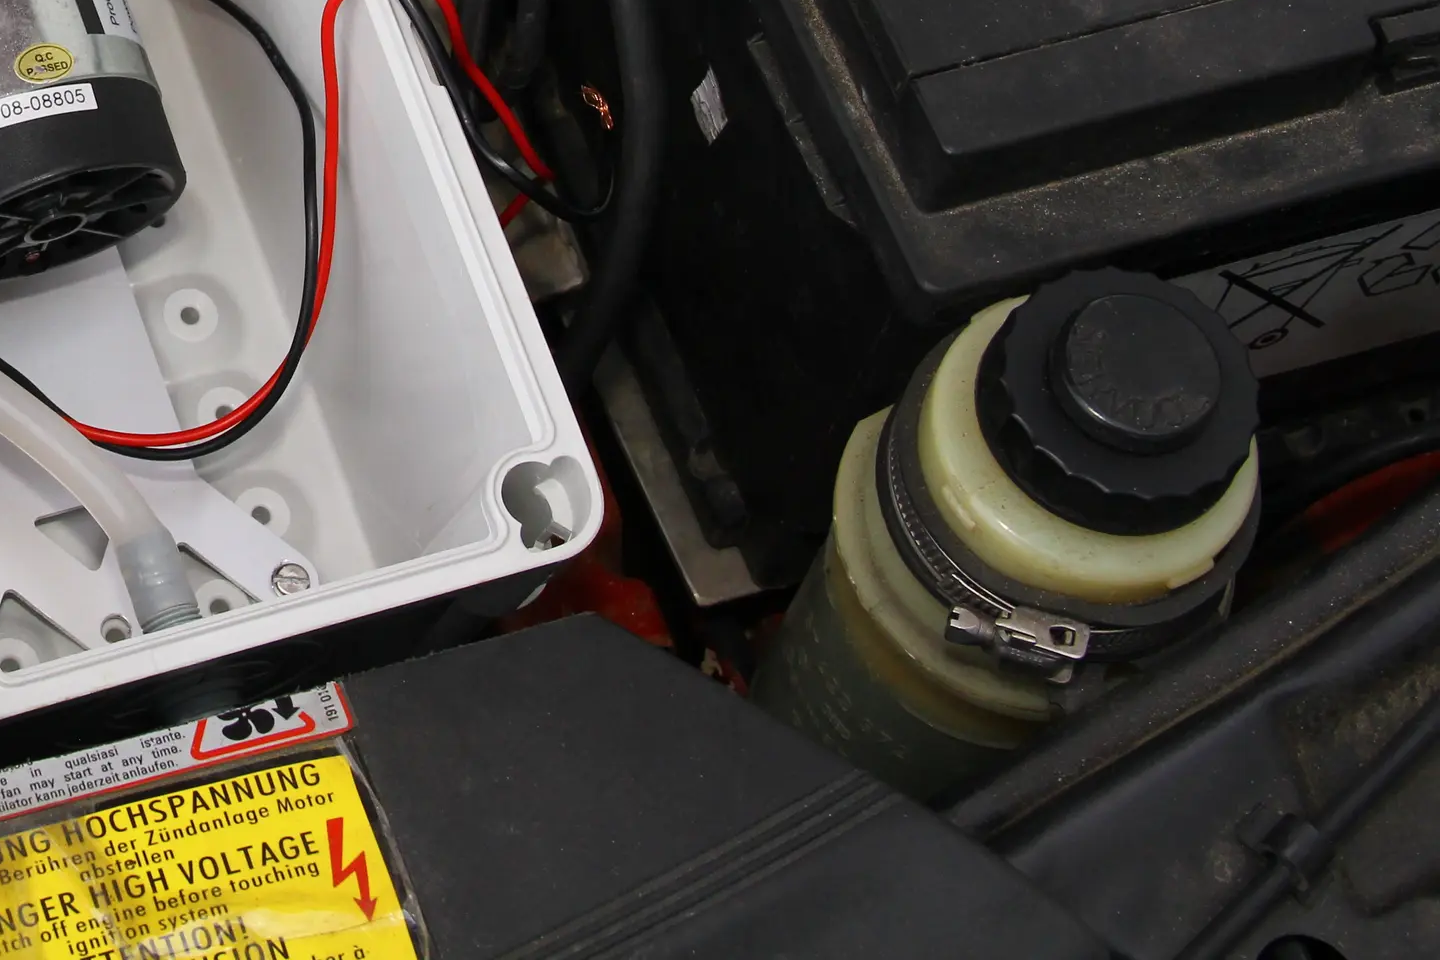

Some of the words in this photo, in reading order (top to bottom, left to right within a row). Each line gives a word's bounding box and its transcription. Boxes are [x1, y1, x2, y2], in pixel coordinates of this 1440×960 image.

[1, 88, 86, 118] 08-08805
[324, 704, 339, 721] 191
[0, 787, 21, 800] fan
[29, 777, 55, 793] may
[64, 767, 93, 783] start
[101, 762, 114, 773] at
[121, 754, 143, 770] any
[152, 745, 182, 760] time.
[30, 767, 42, 778] in
[64, 746, 119, 770] qualsiasi
[35, 787, 66, 804] kann
[66, 772, 120, 797] jederzeit
[122, 759, 179, 781] anlaufen.
[60, 763, 321, 847] HOCHSPANNUNG
[104, 837, 137, 857] der
[144, 806, 270, 846] Zündanlage
[276, 790, 335, 815] Motor
[80, 847, 175, 882] abstellen
[88, 868, 170, 909] HIGH
[177, 831, 320, 886] VOLTAGE
[40, 920, 67, 943] off
[76, 901, 146, 934] engine
[153, 885, 222, 913] before
[229, 861, 320, 894] touching
[68, 922, 150, 957] ignition
[158, 903, 228, 931] system
